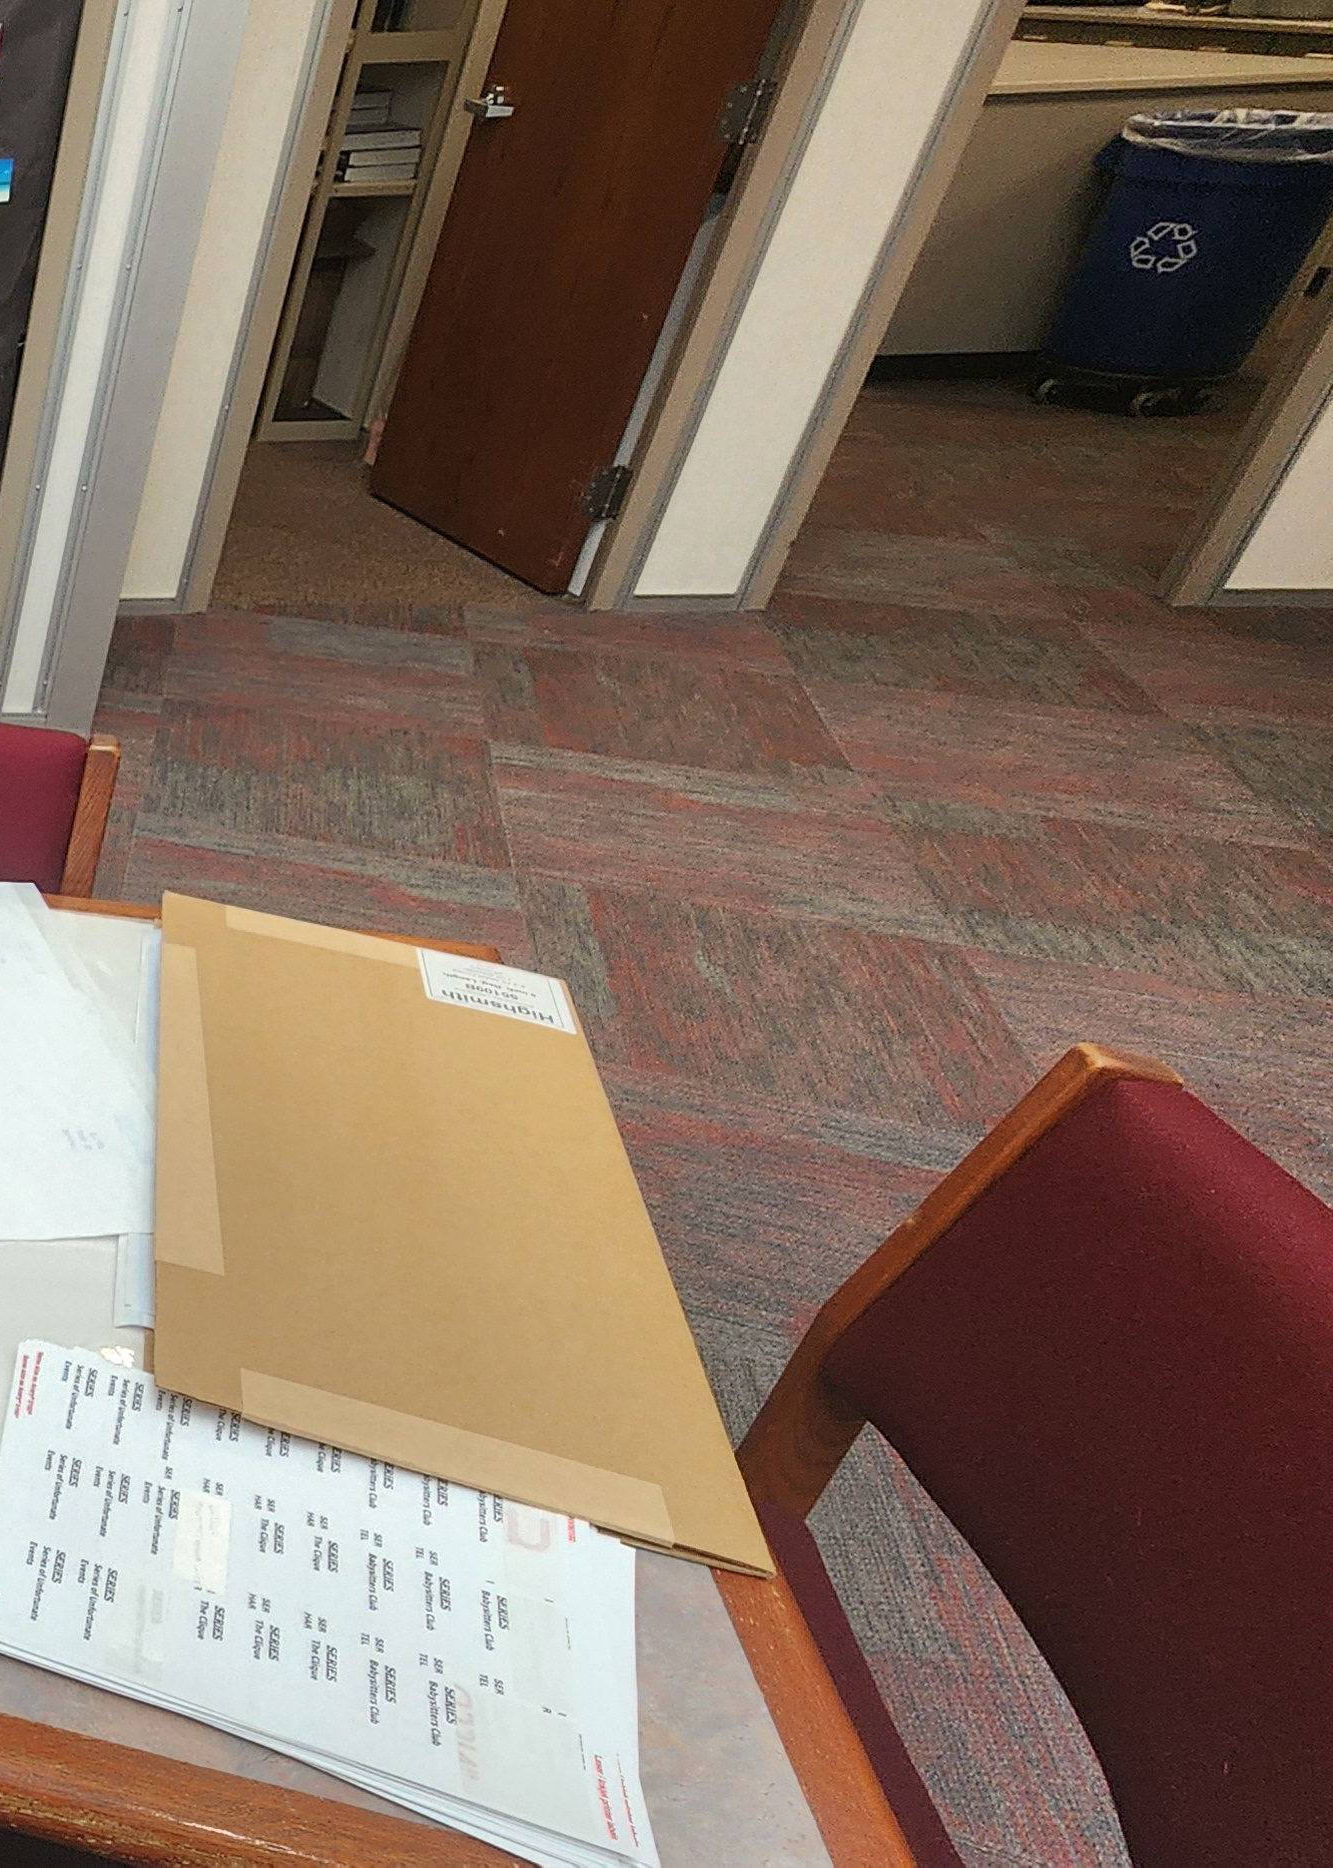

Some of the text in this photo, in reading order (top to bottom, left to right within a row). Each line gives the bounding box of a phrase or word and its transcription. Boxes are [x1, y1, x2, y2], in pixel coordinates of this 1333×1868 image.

[441, 989, 554, 1024] Highsmith
[84, 1367, 98, 1398] SERIES
[132, 1382, 145, 1412] SERIES
[180, 1398, 193, 1427] SERIES
[280, 1431, 291, 1458] ERIES
[68, 1457, 82, 1488] SERIES
[330, 1447, 342, 1474] ERIES
[118, 1473, 131, 1505] SERIES
[383, 1462, 395, 1490] ERIES
[168, 1489, 181, 1520] SERIES
[437, 1477, 450, 1507] ERIES
[492, 1494, 503, 1523] ERIES
[273, 1522, 285, 1555] SERIES
[26, 1541, 38, 1566] Events
[40, 1546, 51, 1567] Series
[52, 1549, 66, 1584] SERIES
[327, 1540, 339, 1573] SERIES
[78, 1559, 89, 1584] Events
[91, 1563, 103, 1586] Series
[104, 1567, 118, 1603] SERIES
[383, 1558, 395, 1592] SERIES
[261, 1597, 271, 1614] SER
[368, 1595, 378, 1611] Club
[439, 1576, 451, 1611] SERIES
[197, 1614, 208, 1640] Clique
[212, 1604, 225, 1641] SERIES
[317, 1616, 327, 1633] SER
[426, 1613, 436, 1631] Club
[497, 1595, 510, 1631] SERIES
[253, 1634, 263, 1660] Clique
[268, 1624, 280, 1662] SERIES
[360, 1632, 370, 1646] TEL
[374, 1636, 385, 1653] SER
[484, 1632, 494, 1651] Club
[309, 1655, 320, 1681] Clique
[326, 1644, 338, 1682] SERIES
[419, 1653, 428, 1667] TEL
[434, 1657, 443, 1674] SER
[369, 1659, 380, 1725] Babysitters Club
[384, 1665, 397, 1704] SERIES
[479, 1674, 489, 1687] TEL
[494, 1678, 504, 1695] SER
[429, 1680, 441, 1747] Babysitters Club
[444, 1686, 457, 1725] SERIES
